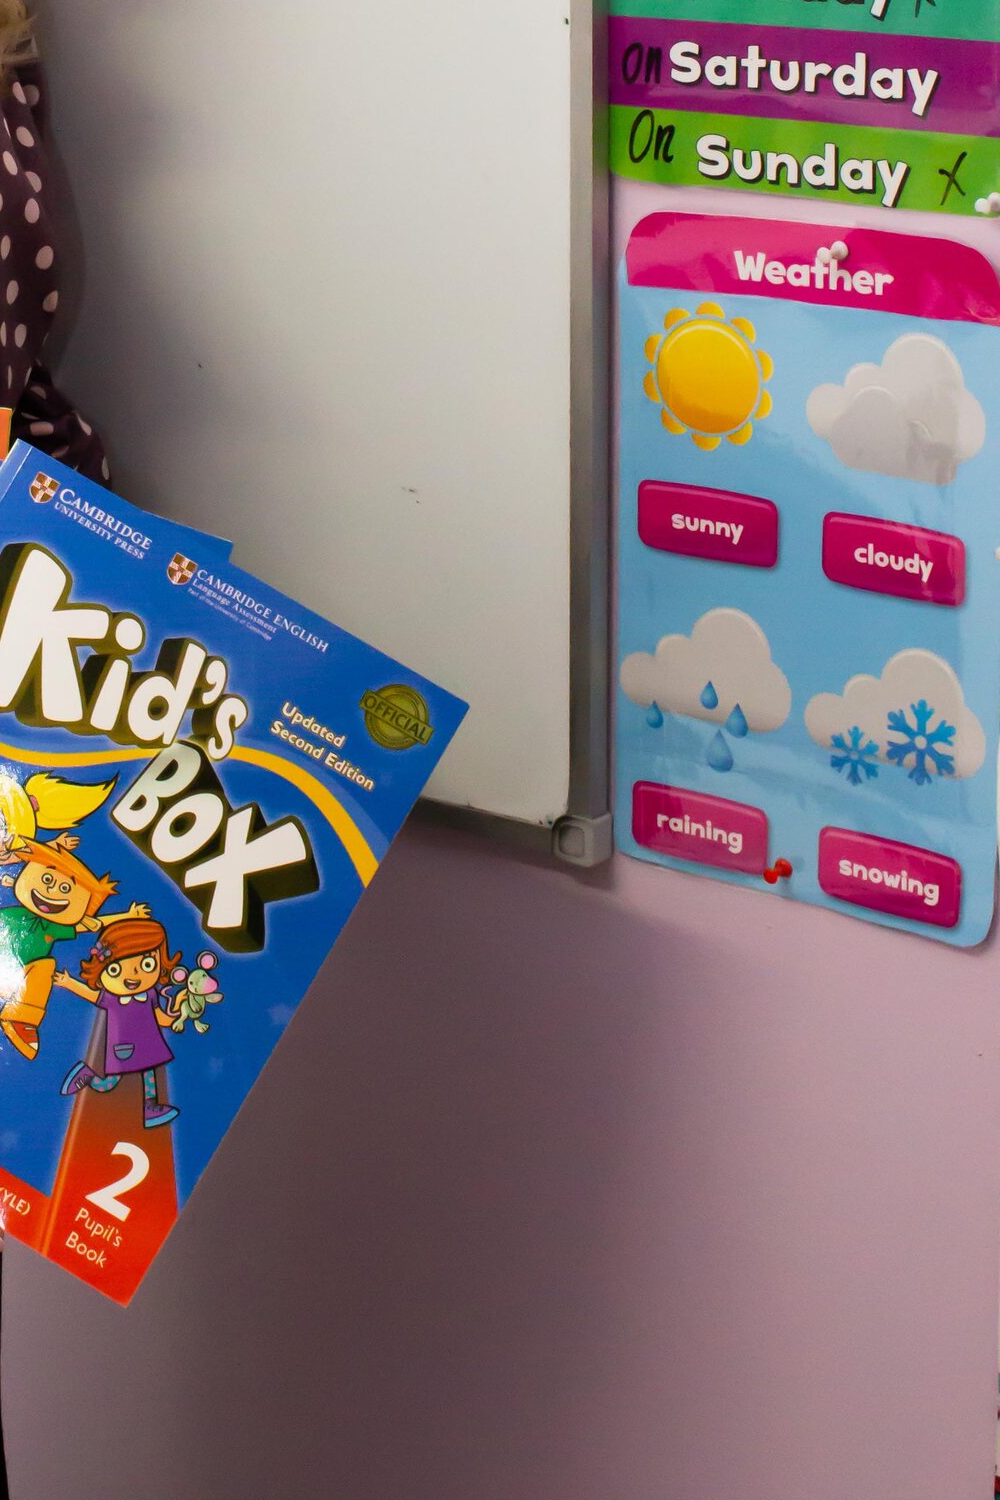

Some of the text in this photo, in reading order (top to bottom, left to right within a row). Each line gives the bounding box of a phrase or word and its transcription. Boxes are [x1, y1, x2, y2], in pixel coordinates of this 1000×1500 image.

[669, 40, 940, 118] Saturday
[696, 133, 909, 208] Sunday
[733, 250, 895, 297] Weather
[54, 501, 145, 560] UNIVERSITY PRESS
[59, 488, 153, 550] CAMBRIDGE
[671, 511, 744, 546] sunny
[854, 543, 934, 583] cloudy
[192, 579, 278, 634] Language Assessment
[197, 569, 329, 653] CAMBRIDGE ENGLISH
[281, 701, 346, 749] Updated
[363, 695, 428, 742] OFFICIAL
[270, 720, 326, 760] Second
[324, 751, 375, 792] Edition
[656, 813, 743, 855] raining
[838, 858, 940, 906] snowing
[85, 1141, 150, 1222] 2
[65, 1231, 108, 1269] Book
[75, 1207, 123, 1249] Pupil's
